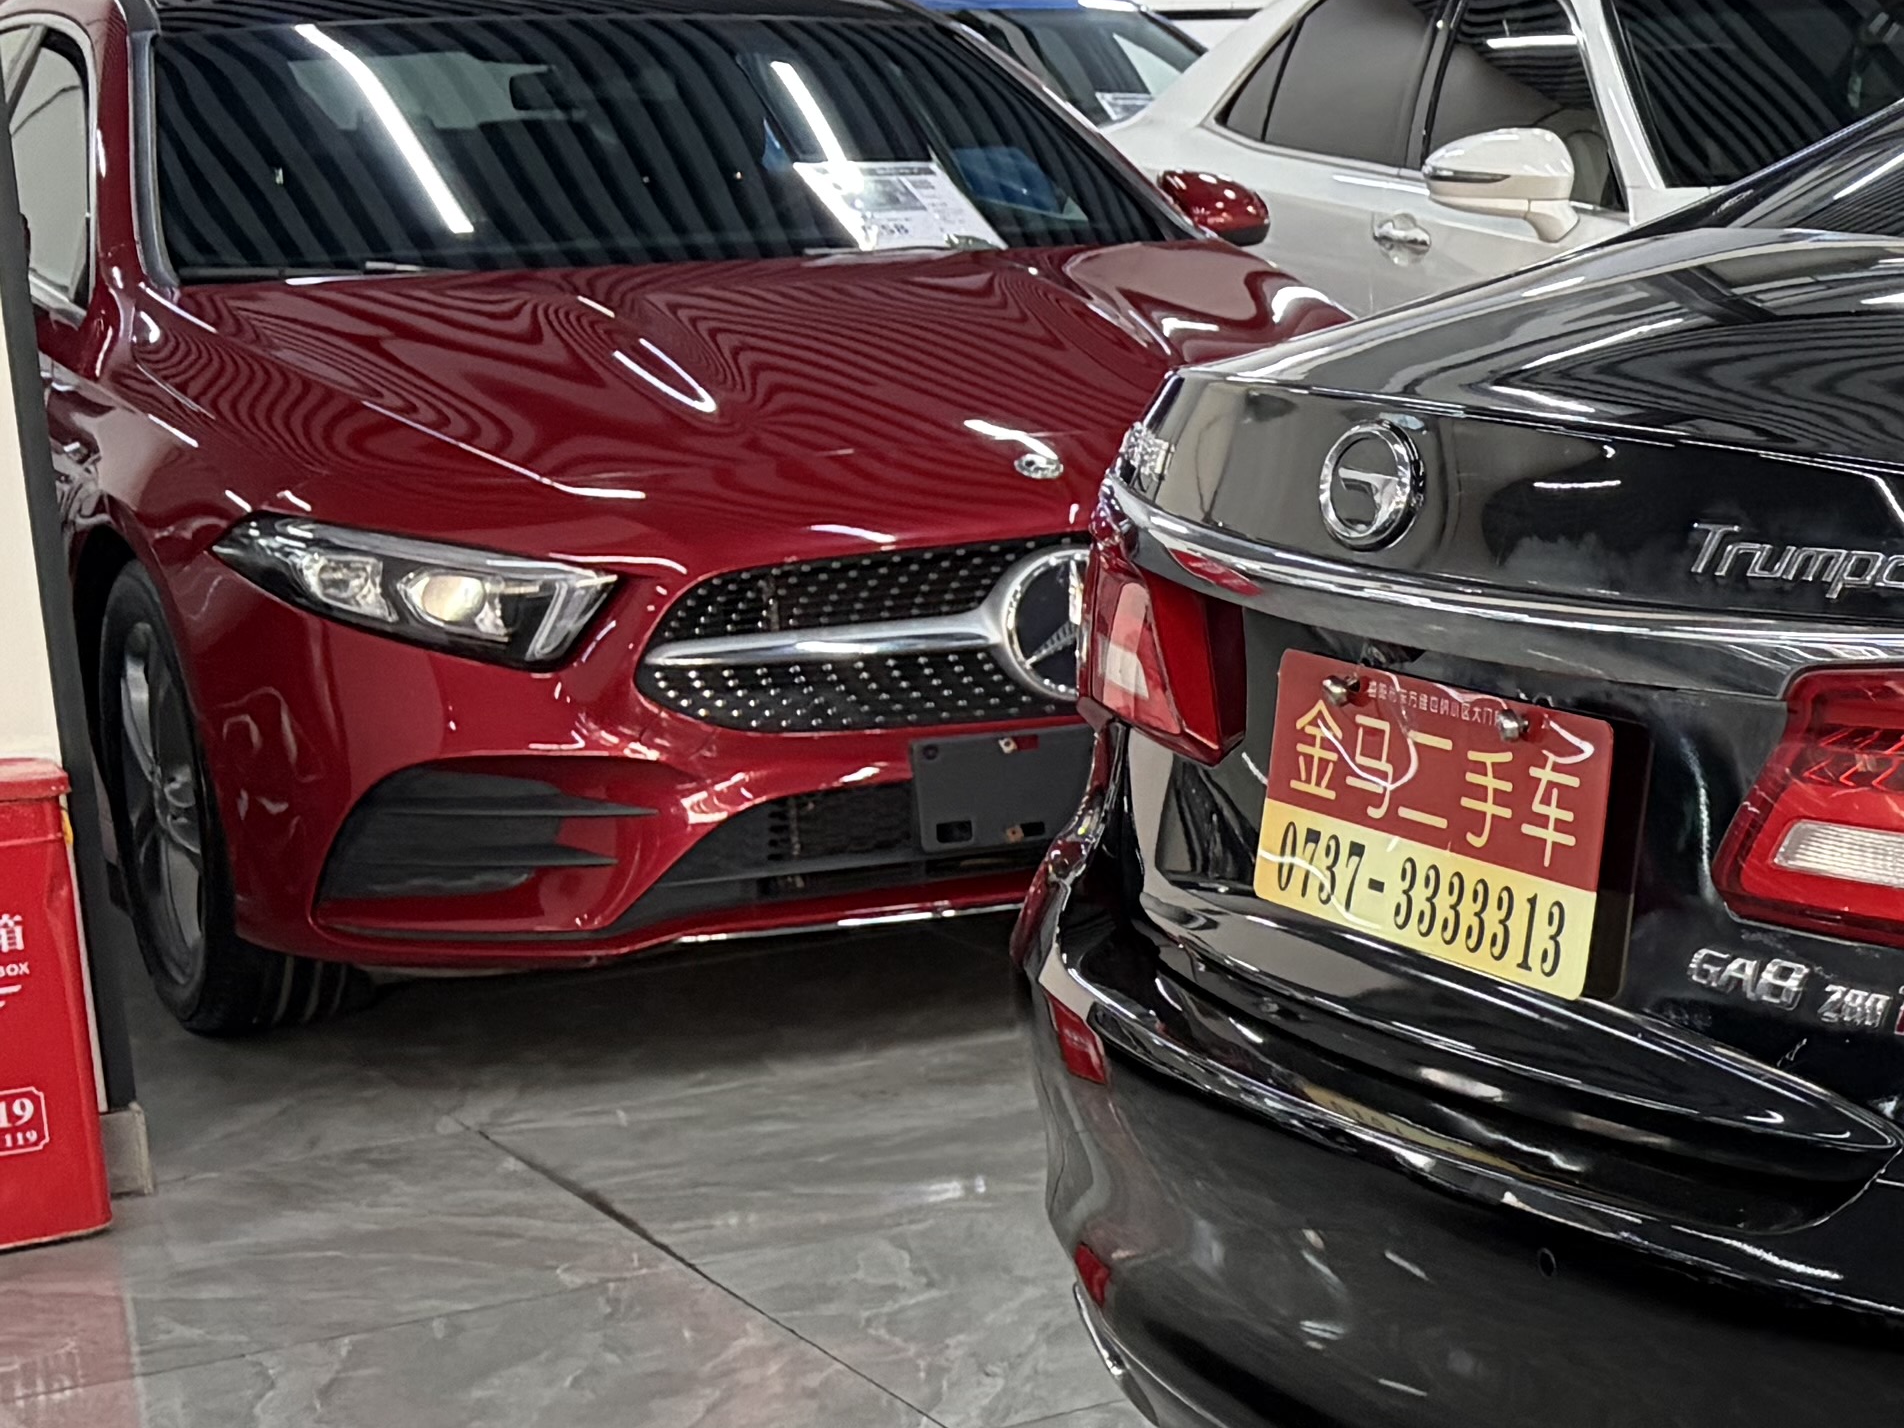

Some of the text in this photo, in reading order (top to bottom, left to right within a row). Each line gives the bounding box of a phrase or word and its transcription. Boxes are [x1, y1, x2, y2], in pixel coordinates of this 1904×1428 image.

[1289, 699, 1581, 868] 金马二手车
[1276, 821, 1566, 978] 0737-3333313
[1688, 947, 1809, 1011] GA8
